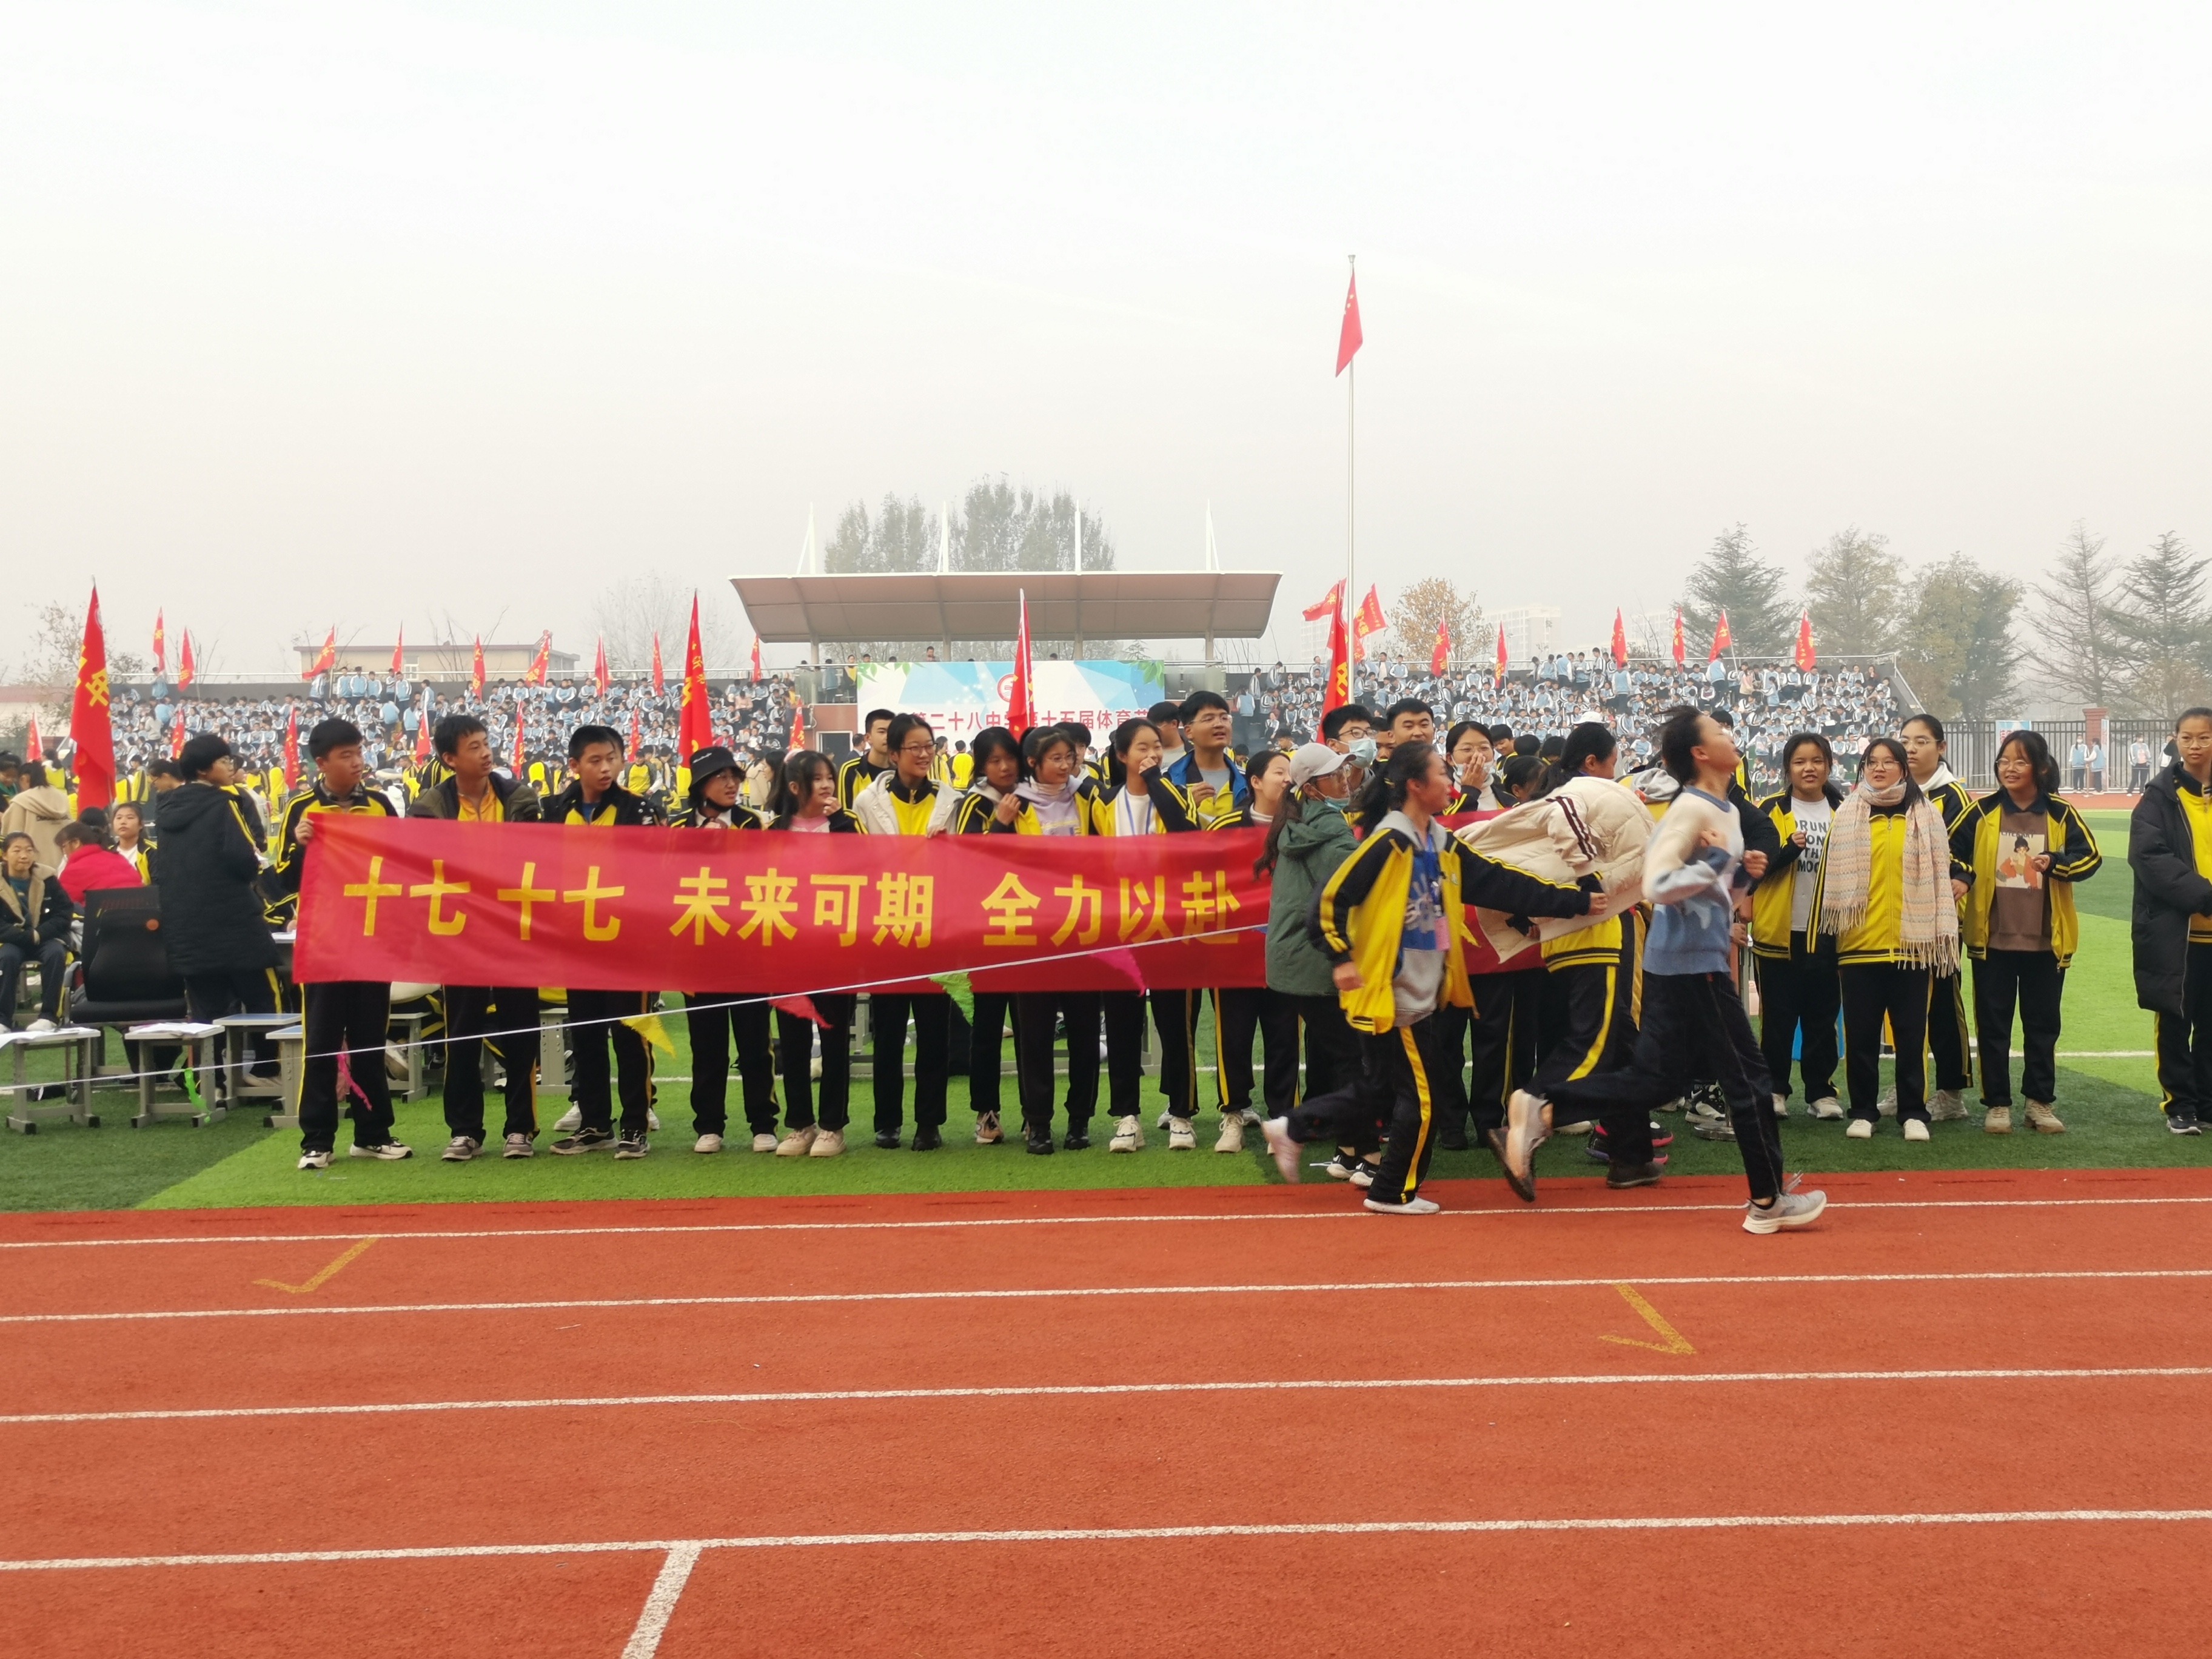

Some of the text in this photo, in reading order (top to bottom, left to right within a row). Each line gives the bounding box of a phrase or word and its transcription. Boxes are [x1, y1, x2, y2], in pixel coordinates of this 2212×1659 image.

[1795, 820, 1831, 833] RUN
[1805, 847, 1823, 859] TH
[1797, 860, 1820, 873] MOO
[343, 856, 1241, 948] 十七 十七 未来可期 全力以赴
